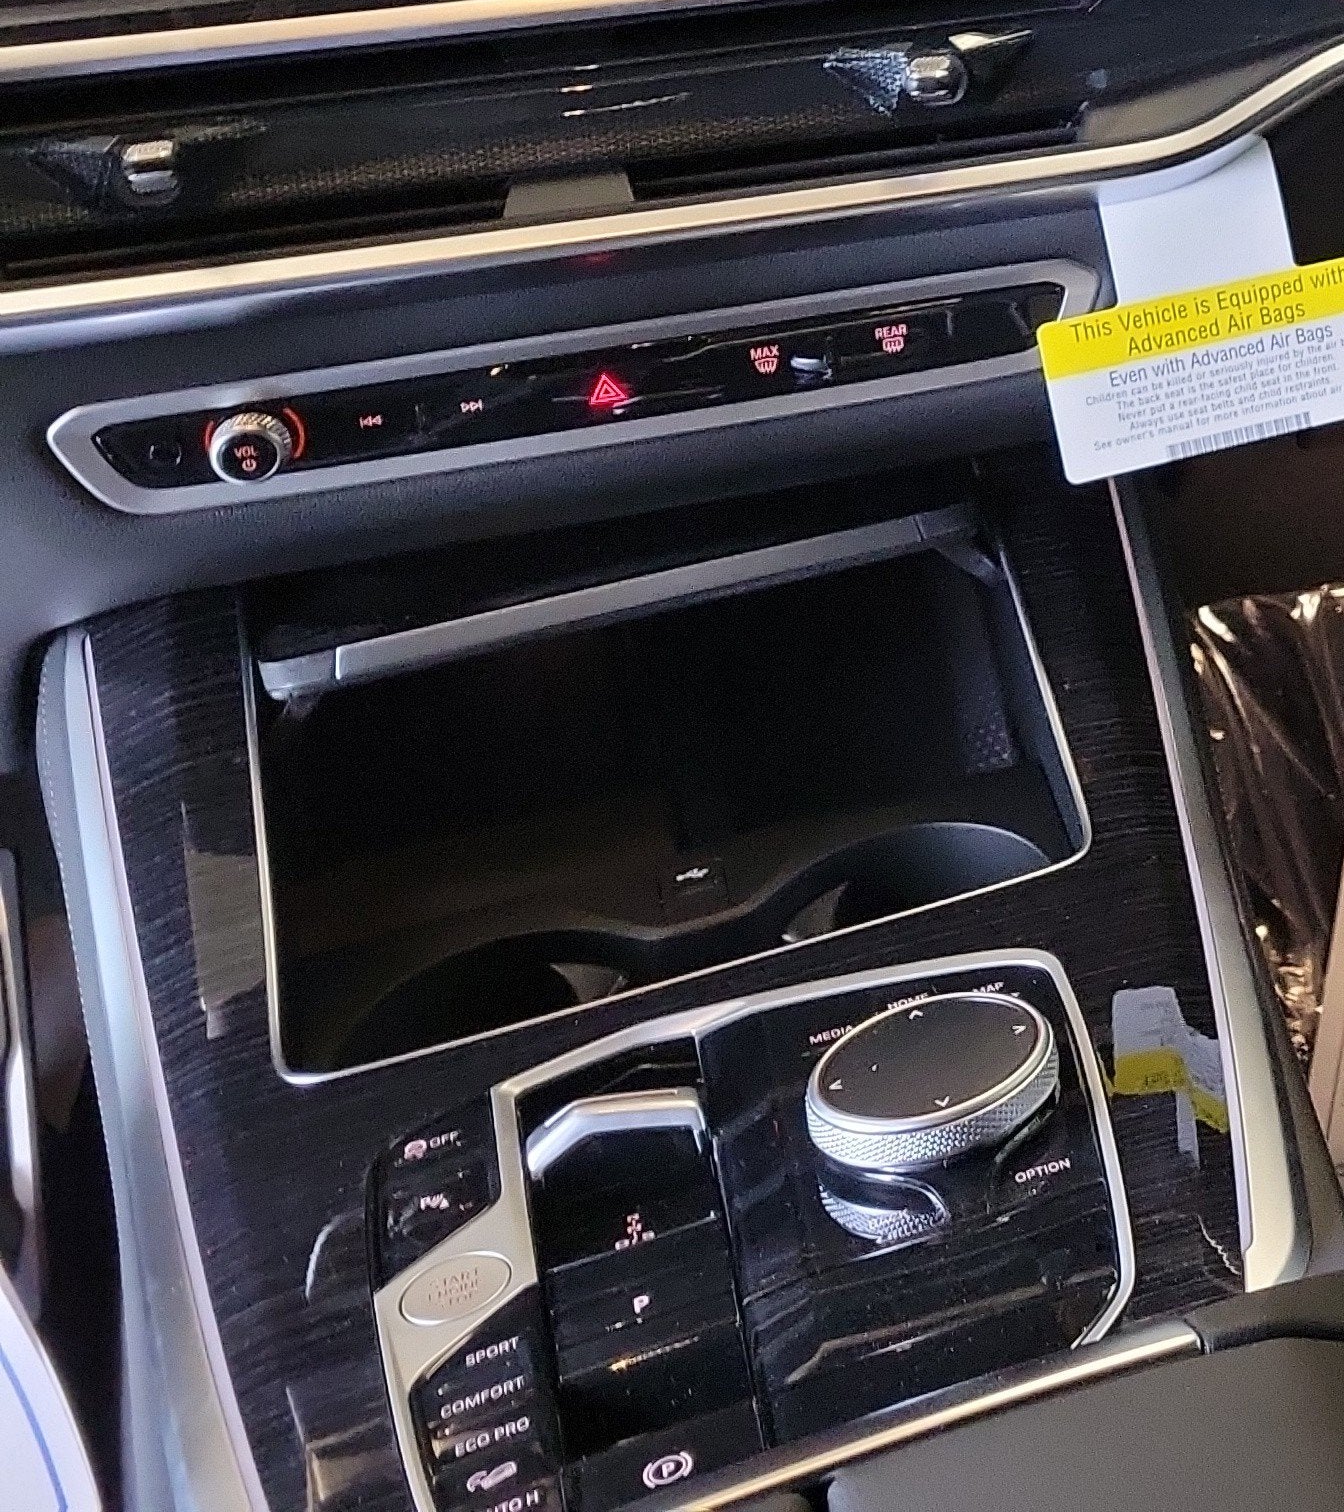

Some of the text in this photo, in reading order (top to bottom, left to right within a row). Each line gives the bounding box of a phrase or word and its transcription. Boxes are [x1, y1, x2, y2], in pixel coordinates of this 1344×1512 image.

[1069, 318, 1113, 343] This
[1118, 301, 1188, 332] Vehicle
[1193, 297, 1211, 316] is
[1216, 273, 1304, 311] Equipped
[874, 324, 908, 340] REAR
[1128, 302, 1306, 357] Advanced Air Bags
[750, 344, 780, 361] MAX
[1109, 325, 1333, 387] Even with Advanced Air Bags
[1085, 388, 1128, 406] Children
[1130, 385, 1149, 396] can
[1151, 380, 1164, 391] be
[1166, 373, 1193, 387] killed
[1196, 372, 1206, 381] or
[1209, 359, 1254, 379] seriously
[1257, 351, 1291, 368] injured
[1293, 348, 1305, 360] by
[1307, 343, 1322, 355] the
[1117, 398, 1135, 410] The
[1138, 393, 1161, 405] back
[1164, 387, 1185, 399] seat
[1187, 384, 1196, 394] is
[1198, 380, 1215, 391] the
[1218, 373, 1247, 387] safest
[1250, 366, 1275, 381] place
[1278, 362, 1293, 373] for
[1118, 408, 1147, 422] Never
[1150, 403, 1167, 416] put
[1233, 382, 1258, 395] child
[1260, 377, 1281, 389] seat
[1283, 374, 1293, 383] in
[1295, 370, 1311, 381] the
[1129, 415, 1165, 433] Always
[1167, 412, 1185, 422] use
[1187, 405, 1209, 417] seat
[1211, 399, 1235, 412] belts
[1237, 394, 1256, 406] and
[1258, 388, 1282, 401] child
[1157, 419, 1193, 435] manual
[1196, 415, 1211, 426] for
[1213, 410, 1239, 422] more
[1241, 395, 1298, 416] information
[1300, 388, 1327, 402] about
[234, 445, 258, 459] VOL
[809, 1024, 853, 1045] MEDIA
[430, 1131, 459, 1148] OFF
[1014, 1157, 1071, 1183] OPTION
[633, 1295, 650, 1314] P
[465, 1336, 519, 1368] SPORT
[440, 1375, 525, 1420] COMFORT
[455, 1416, 531, 1458] ECO PRO
[661, 1462, 675, 1478] P
